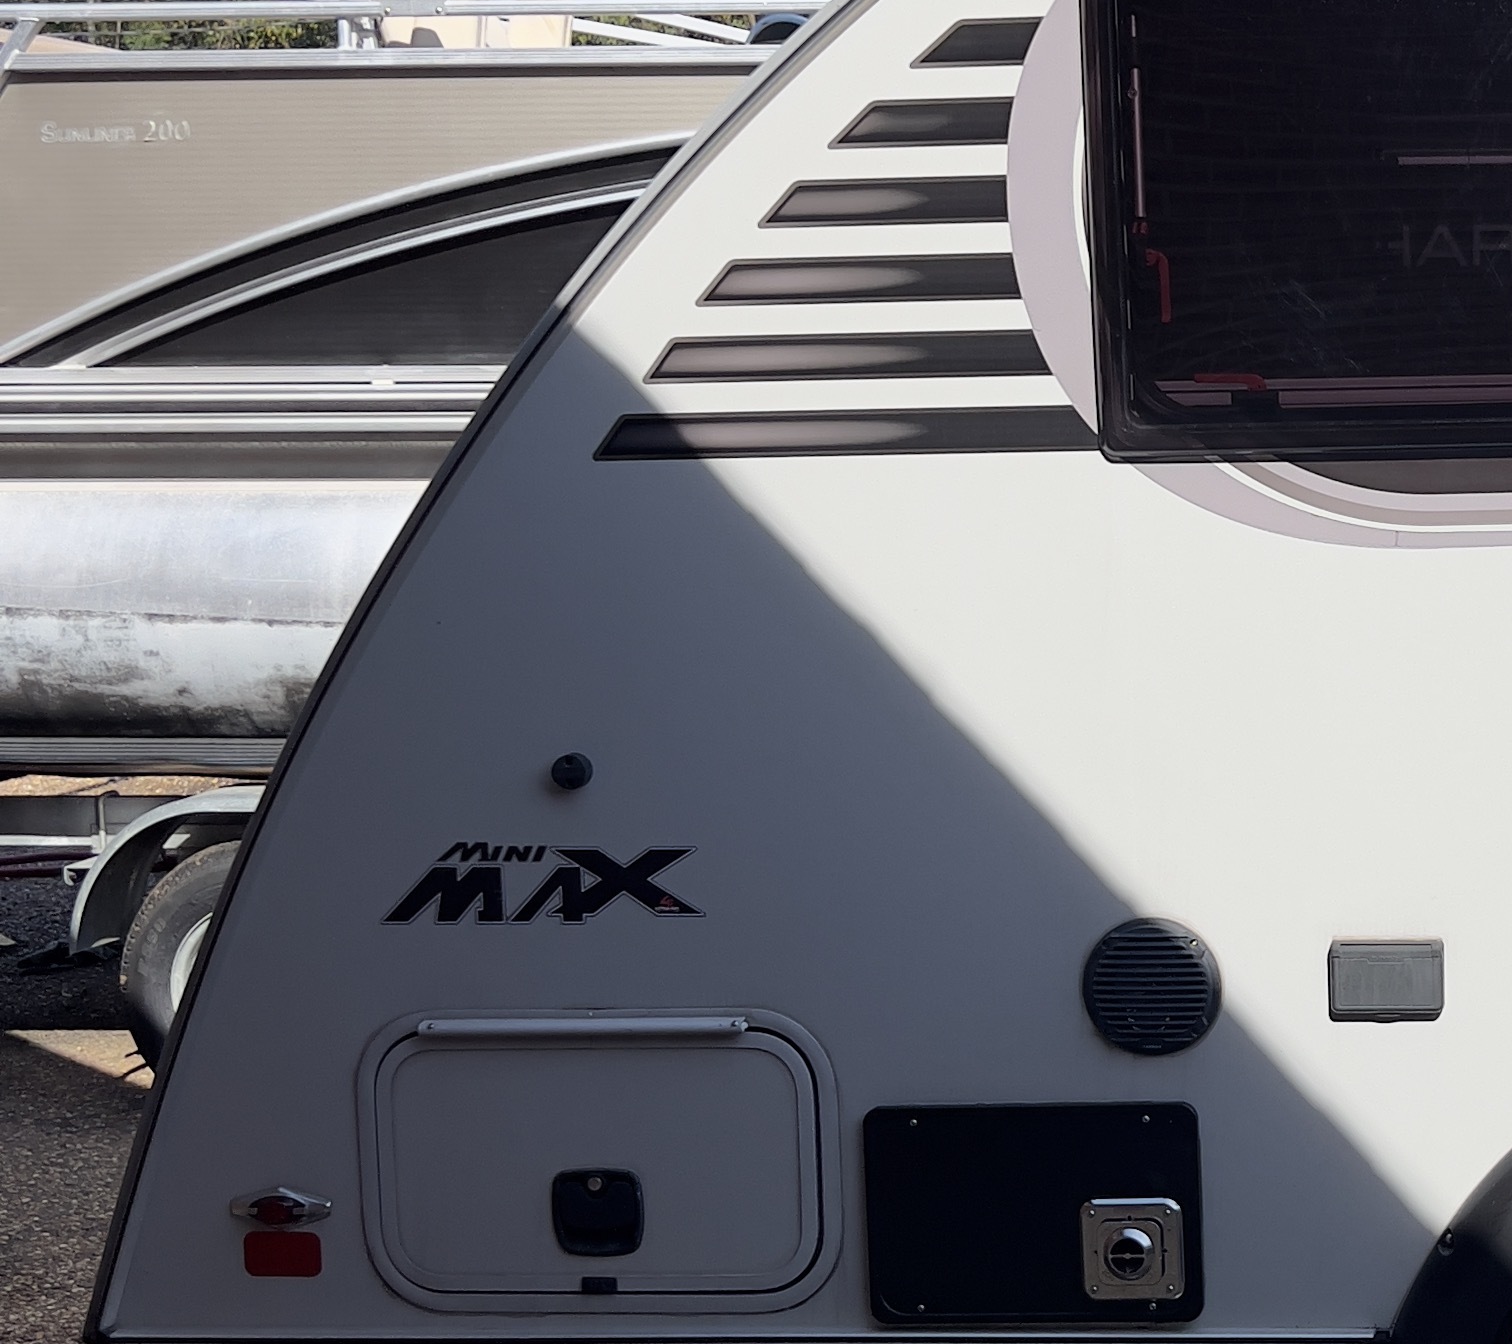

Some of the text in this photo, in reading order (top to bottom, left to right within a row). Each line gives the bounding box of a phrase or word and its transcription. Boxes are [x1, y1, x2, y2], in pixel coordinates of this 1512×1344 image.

[142, 119, 192, 143] 200
[436, 842, 548, 862] MINI
[380, 845, 707, 925] MAX
